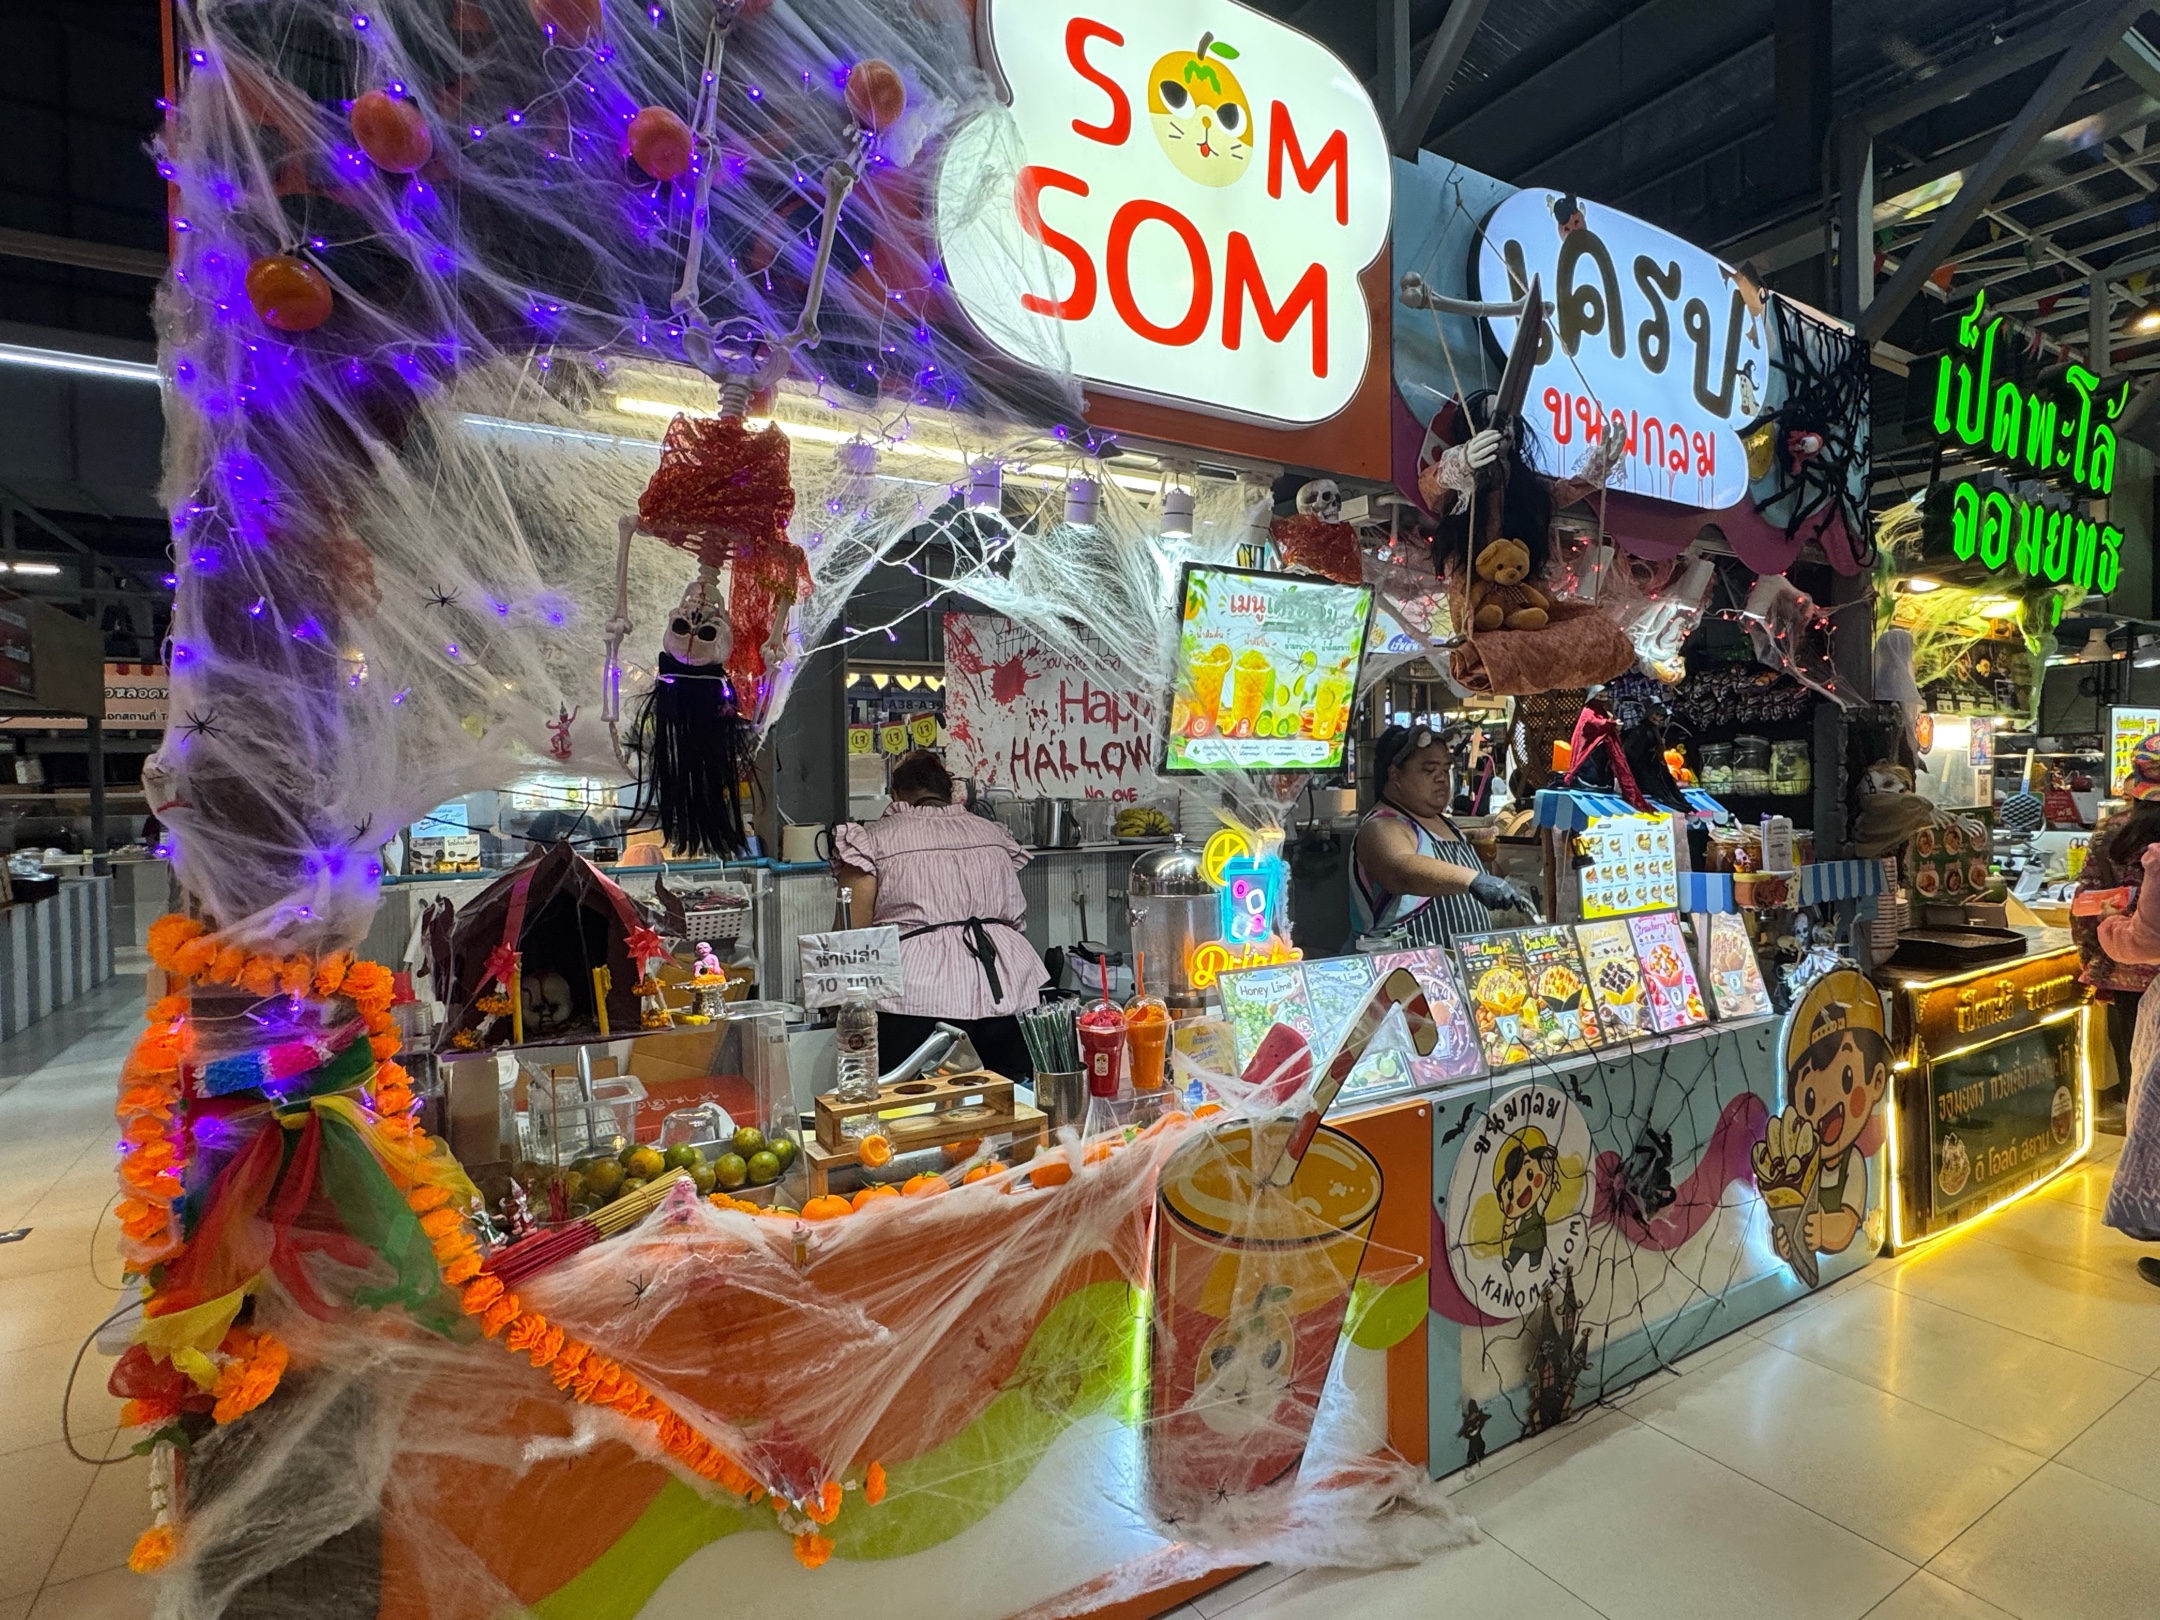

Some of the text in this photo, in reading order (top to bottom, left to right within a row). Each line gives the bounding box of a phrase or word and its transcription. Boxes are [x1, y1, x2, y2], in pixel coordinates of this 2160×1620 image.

[1014, 165, 1328, 378] SOM
[1504, 229, 1745, 419] เครป
[1934, 288, 2129, 495] เป็ดพะโล้
[1543, 386, 1716, 478] ขนมกลม
[1953, 482, 2125, 628] จอมยุทธ
[1060, 677, 1154, 735] Happ
[1462, 941, 1503, 957] Ham Cheese
[1524, 937, 1540, 952] Crab
[1540, 936, 1559, 949] Stick
[1634, 922, 1667, 938] Strawberry
[815, 942, 880, 968] น้ำเปล่า
[817, 975, 883, 993] 10 บาท
[1239, 979, 1292, 999] Honey Lime
[1343, 972, 1363, 981] Lime
[1474, 1093, 1560, 1154] ขนมกลม
